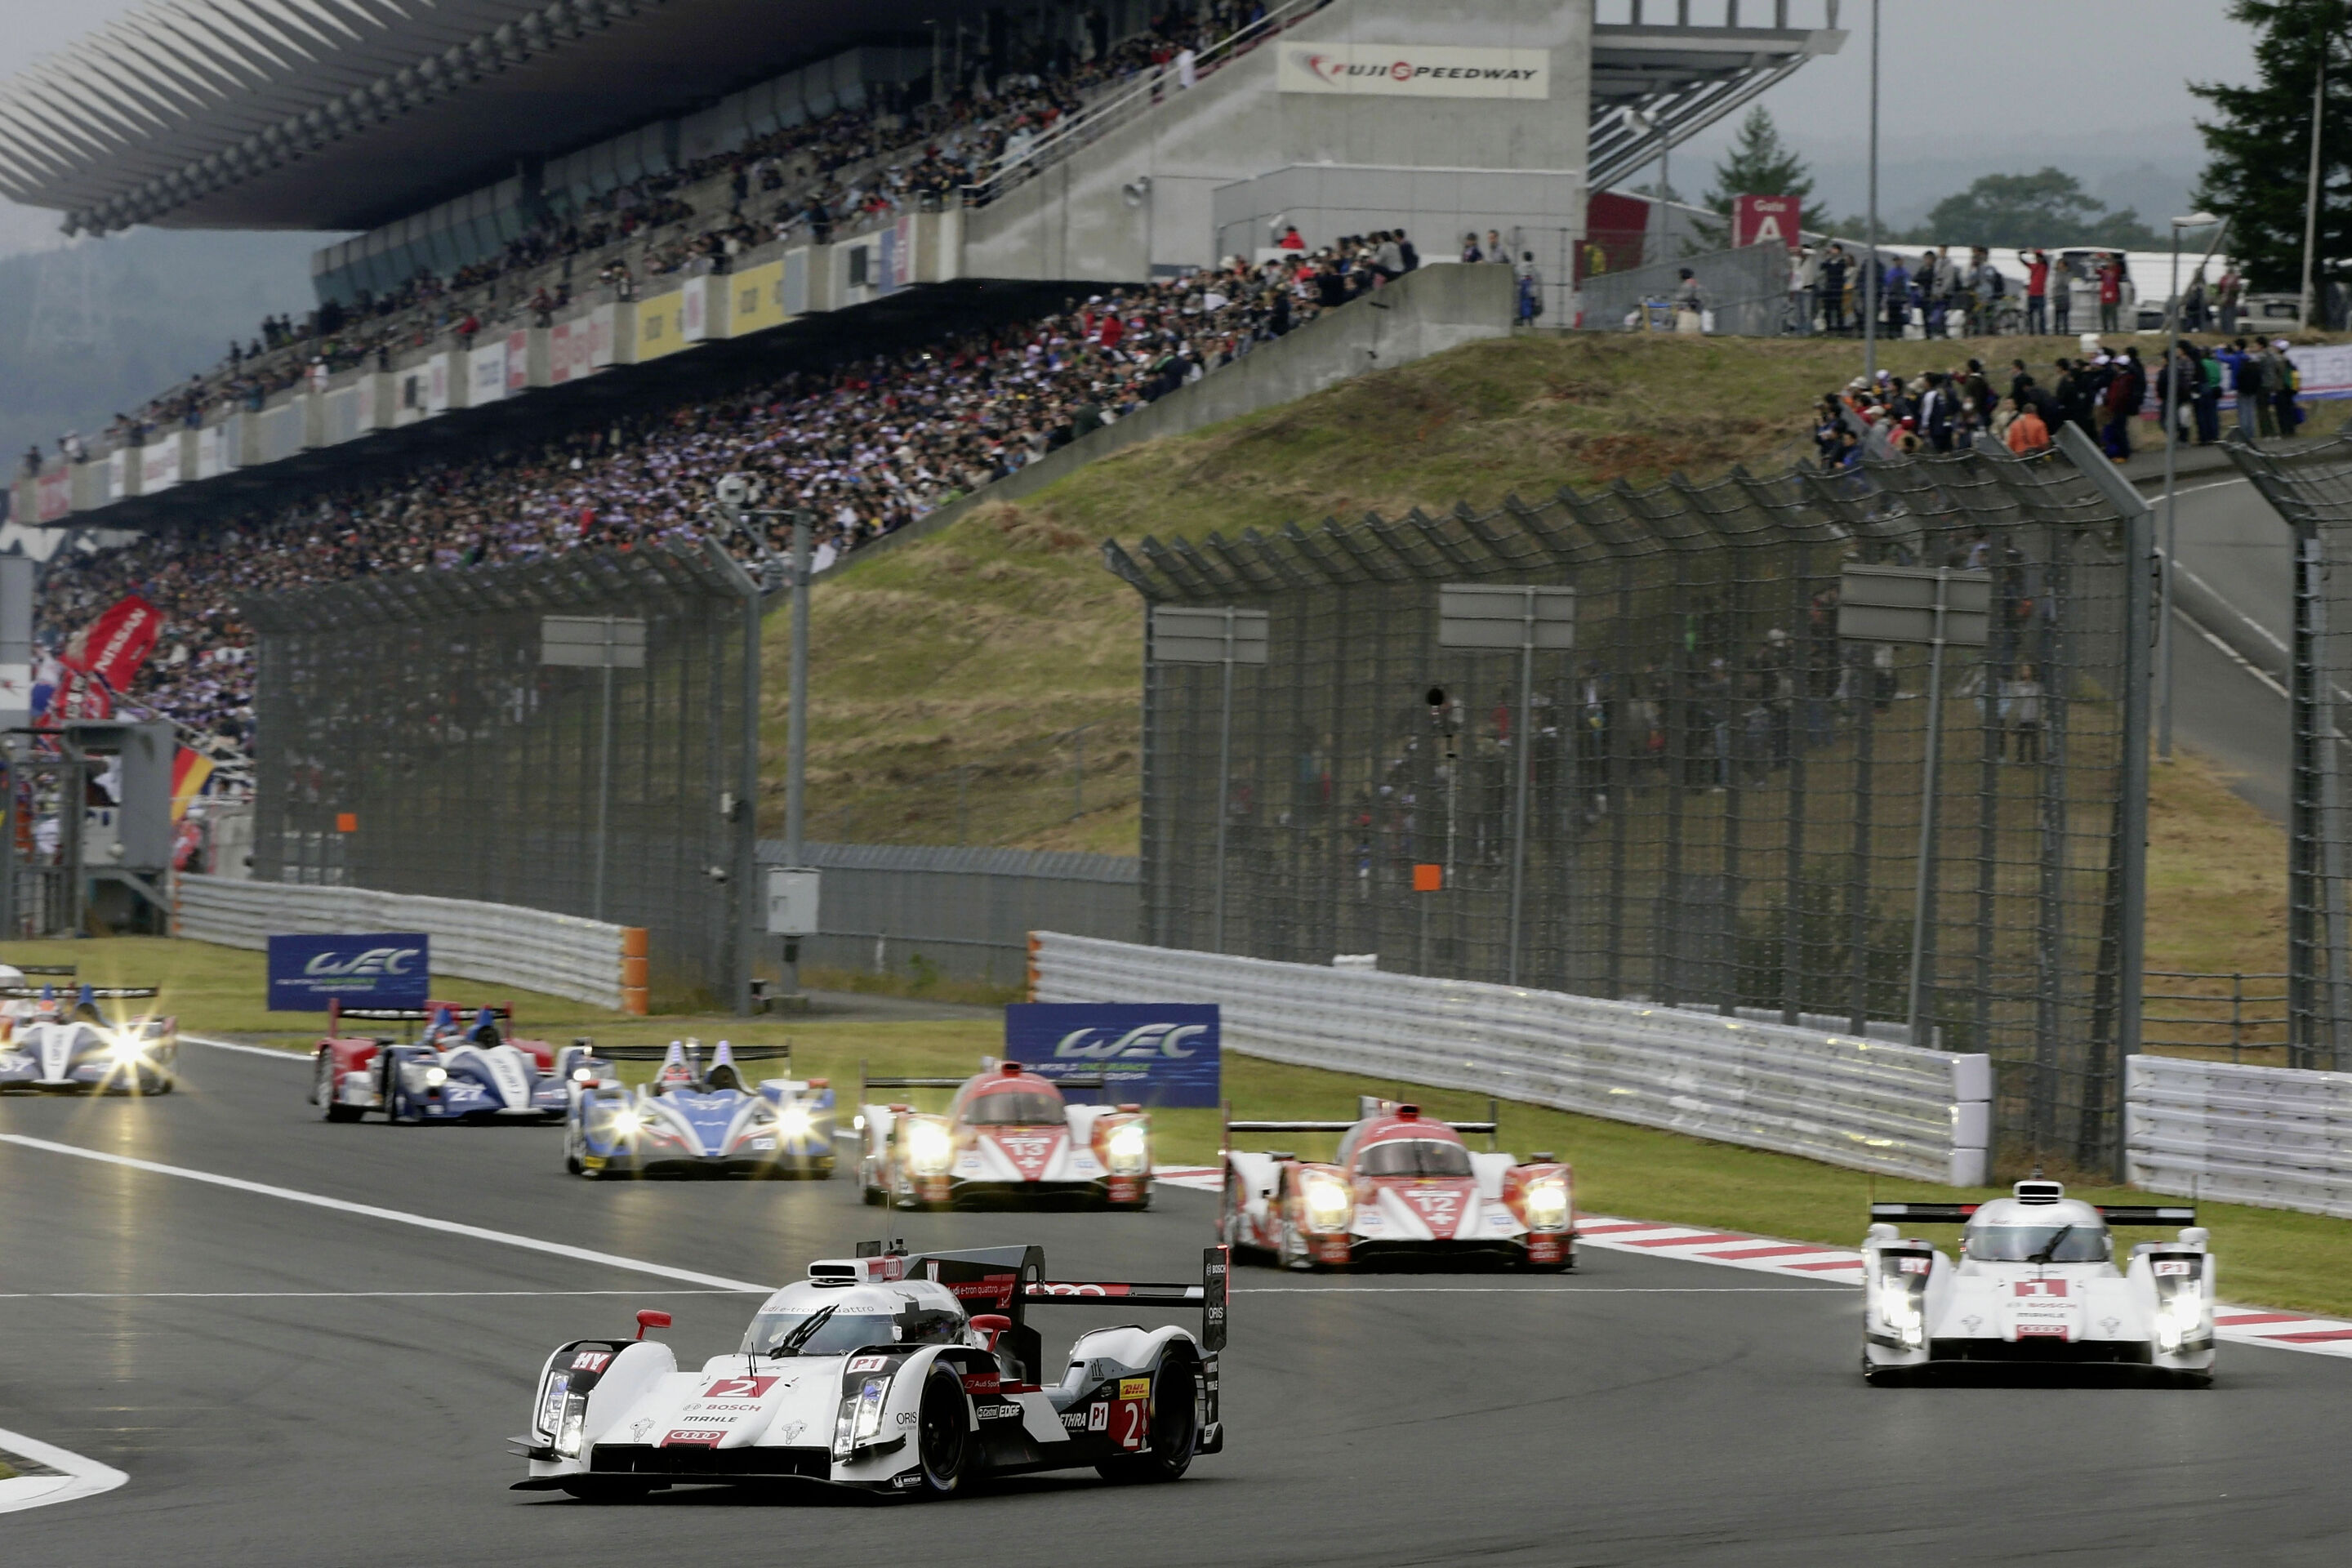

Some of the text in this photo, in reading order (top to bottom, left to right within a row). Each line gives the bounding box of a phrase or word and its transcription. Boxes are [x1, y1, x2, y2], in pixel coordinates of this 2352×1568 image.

[1330, 63, 1388, 77] FUJI
[1754, 216, 1781, 245] A
[94, 608, 147, 672] NISSAN
[304, 948, 421, 974] WEC
[1054, 1023, 1209, 1058] WEC
[449, 1088, 483, 1101] 27
[1008, 1143, 1045, 1156] 13
[1415, 1197, 1458, 1212] 12
[1212, 1265, 1226, 1273] BOSCH
[978, 1286, 998, 1295] quattro
[2025, 1283, 2056, 1297] 1
[1209, 1307, 1223, 1319] ORIS
[572, 1352, 609, 1370] HY
[853, 1359, 880, 1370] P1
[1090, 1359, 1104, 1376] itk
[717, 1380, 757, 1396] 2
[1125, 1383, 1143, 1395] DHL
[896, 1411, 917, 1424] ORIS
[982, 1405, 1020, 1418] Castrol EDGE
[1092, 1406, 1105, 1427] P1
[1123, 1402, 1138, 1447] 2
